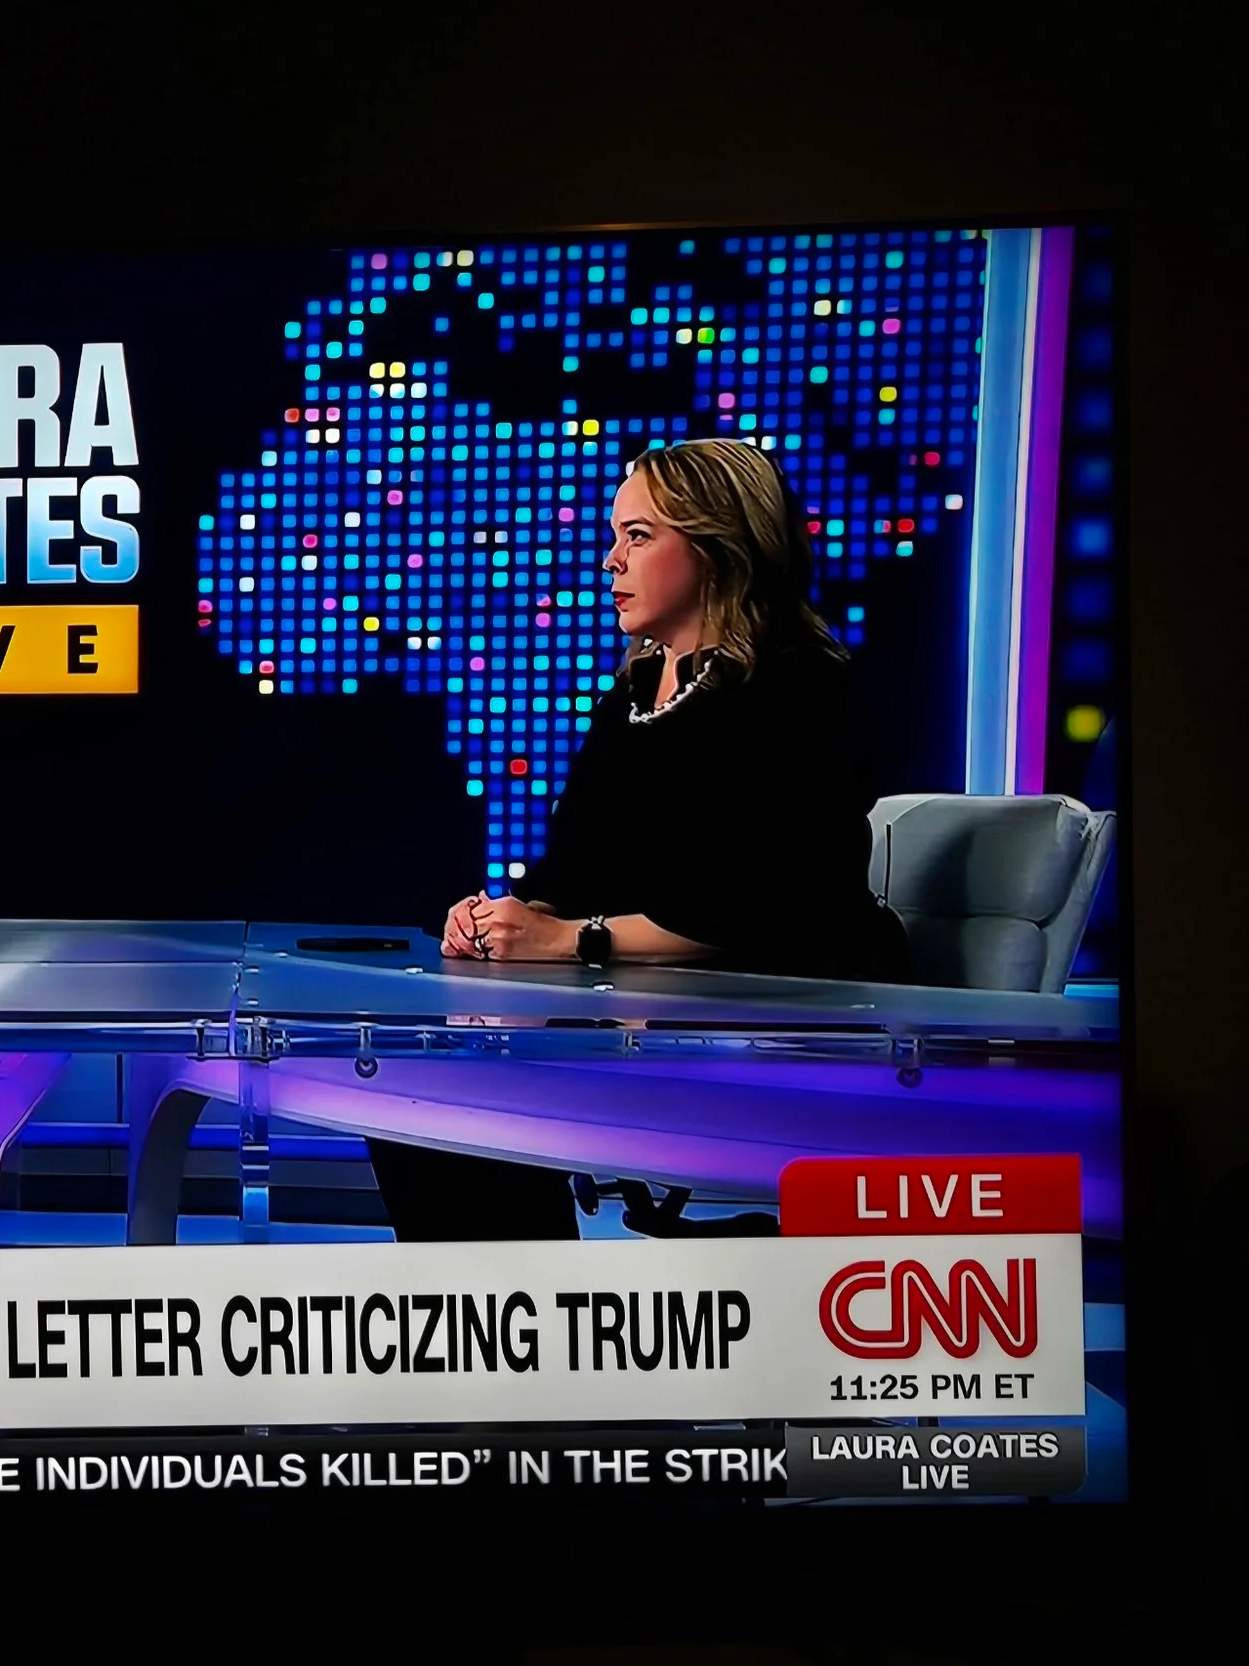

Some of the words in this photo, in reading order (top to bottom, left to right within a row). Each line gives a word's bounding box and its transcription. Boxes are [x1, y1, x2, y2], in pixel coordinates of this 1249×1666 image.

[856, 1173, 1004, 1219] LIVE
[819, 1258, 1037, 1360] CNN
[7, 1297, 204, 1380] LETTER
[220, 1290, 540, 1378] CRITICIZING
[555, 1289, 751, 1372] TRUMP
[830, 1373, 919, 1401] 11:25
[931, 1373, 982, 1400] PM
[994, 1373, 1035, 1399] ET
[812, 1435, 920, 1460] LAURA
[930, 1433, 1059, 1459] COATES
[36, 1453, 307, 1491] INDIVIDUALS
[321, 1448, 491, 1486] KILLED”
[508, 1450, 550, 1484] IN
[563, 1449, 651, 1483] THE
[665, 1448, 787, 1483] STRIK
[902, 1464, 970, 1490] LIVE
